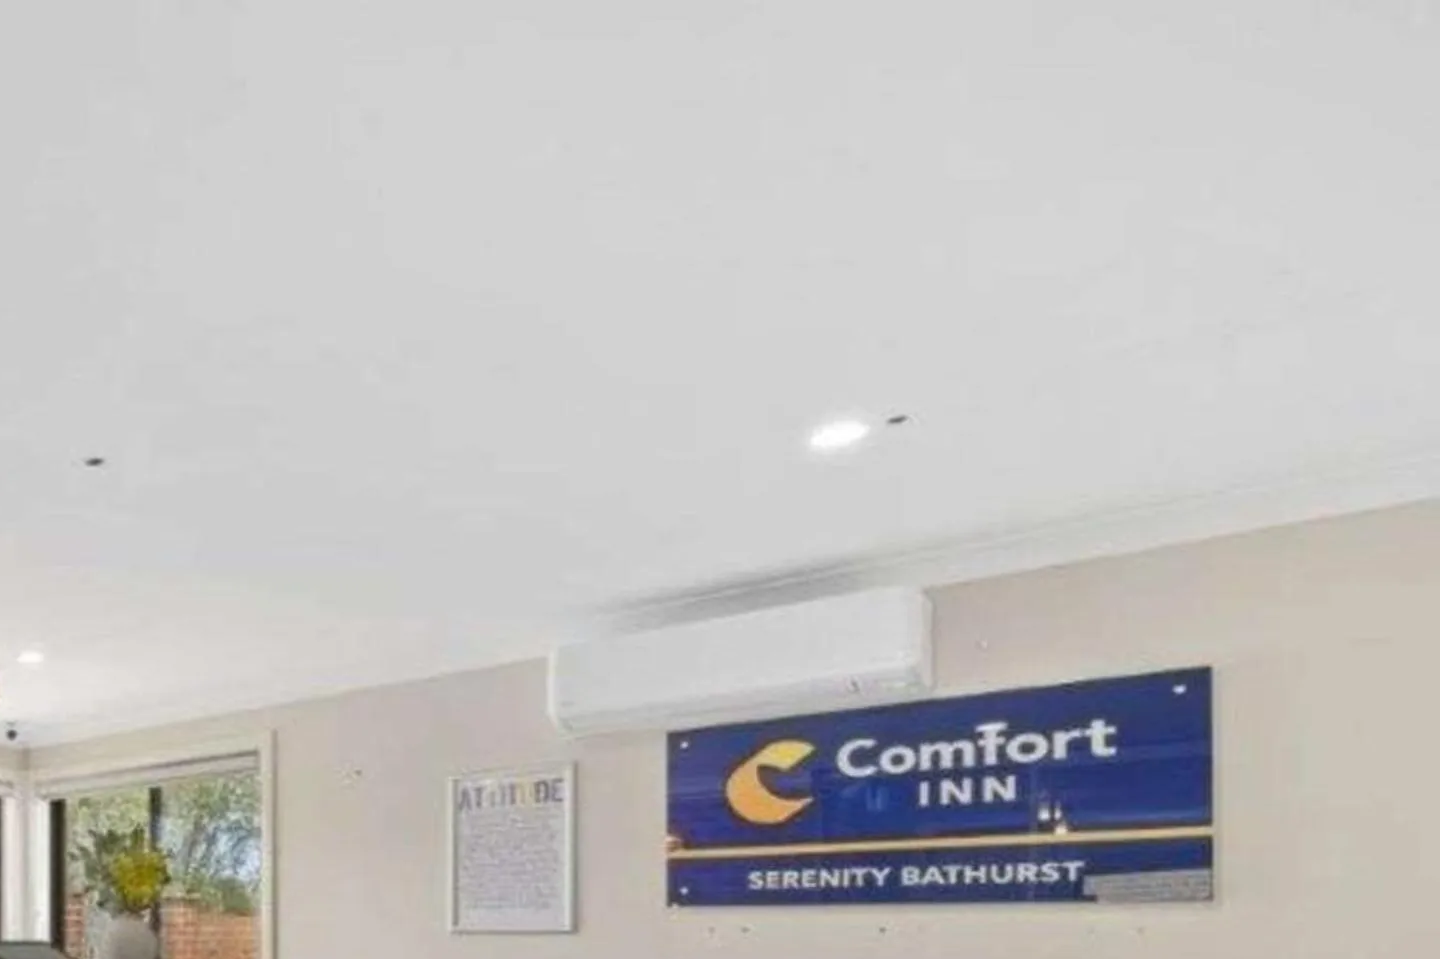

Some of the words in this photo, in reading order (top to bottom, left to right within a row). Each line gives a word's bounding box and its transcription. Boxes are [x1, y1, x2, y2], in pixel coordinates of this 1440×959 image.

[836, 719, 1117, 778] Comfort
[918, 775, 1016, 807] INN
[747, 867, 892, 890] SERENITY
[900, 861, 1085, 886] BATHURST
